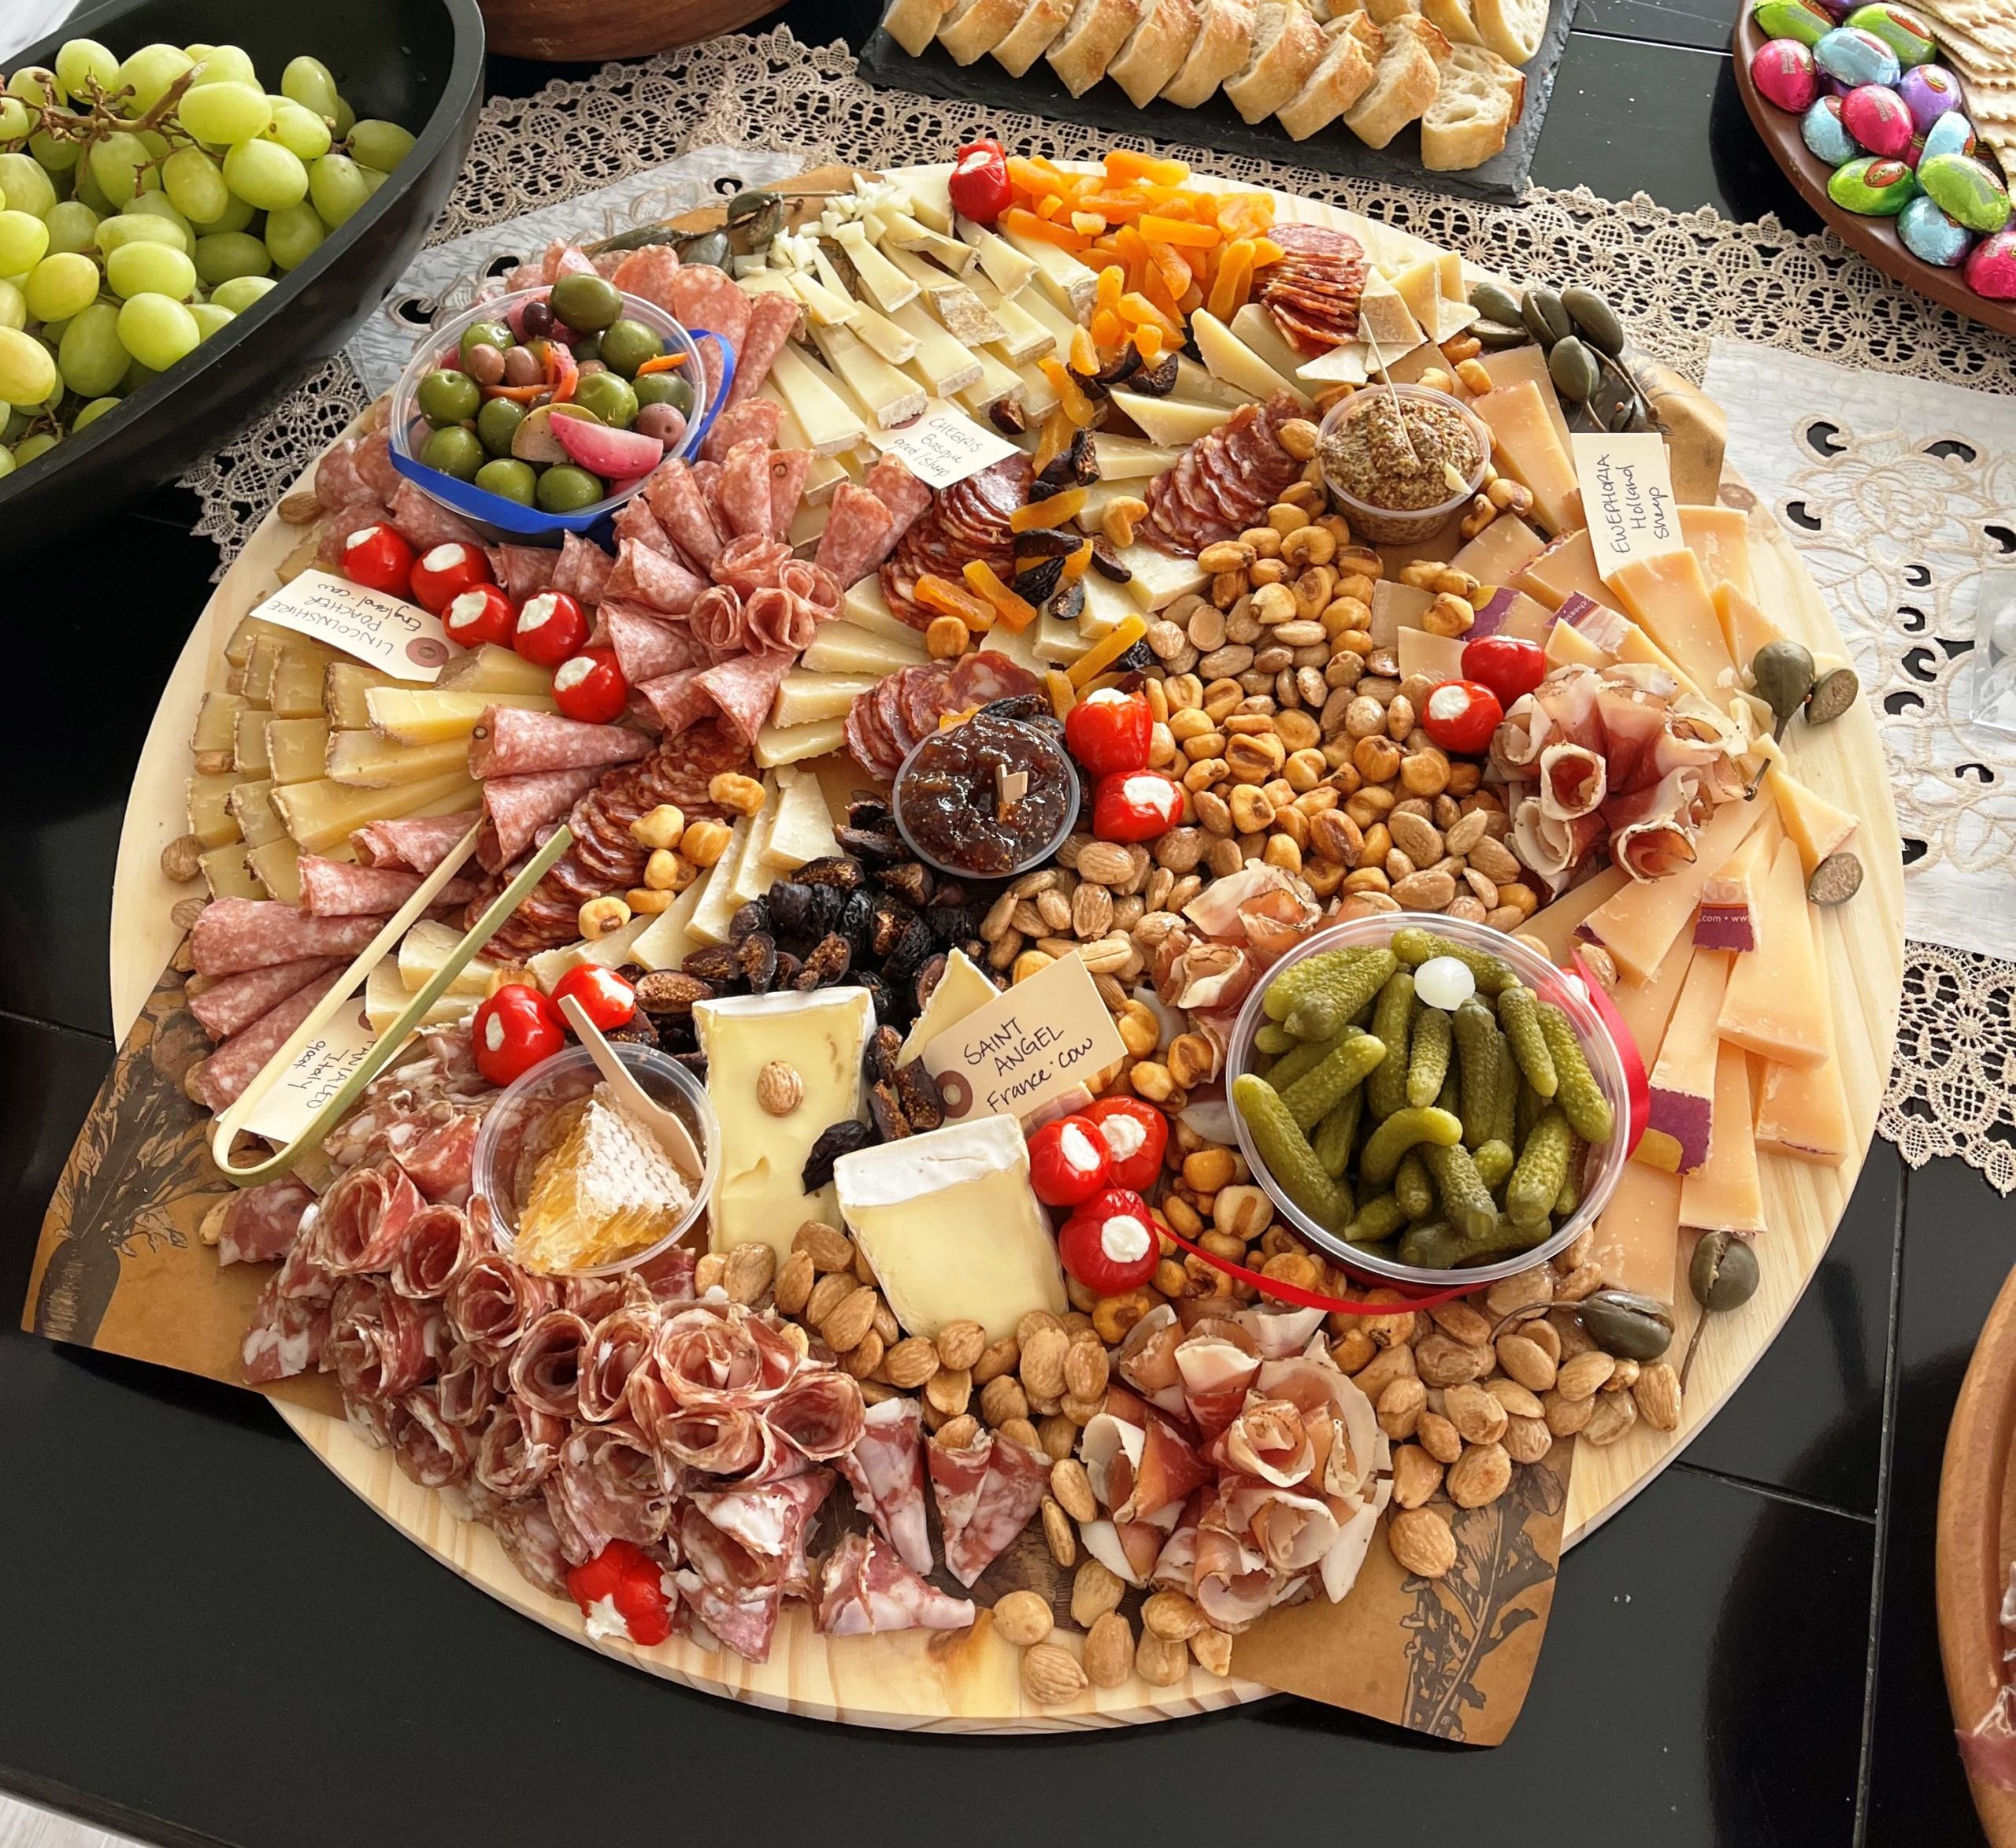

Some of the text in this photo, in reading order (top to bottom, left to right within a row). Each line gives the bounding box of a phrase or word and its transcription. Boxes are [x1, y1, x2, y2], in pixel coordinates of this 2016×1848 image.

[921, 434, 962, 464] Basque
[929, 417, 983, 453] CHEBRIS
[1596, 454, 1631, 553] EWEPHORIA
[1615, 465, 1647, 529] Holland
[266, 600, 394, 656] LINCOLNSHIRE
[304, 595, 383, 631] POACHER
[292, 1040, 326, 1069] goat
[964, 1017, 1022, 1065] SAINT
[994, 1026, 1065, 1077] ANGEL
[287, 1050, 350, 1090] Italy
[987, 1069, 1052, 1113] France
